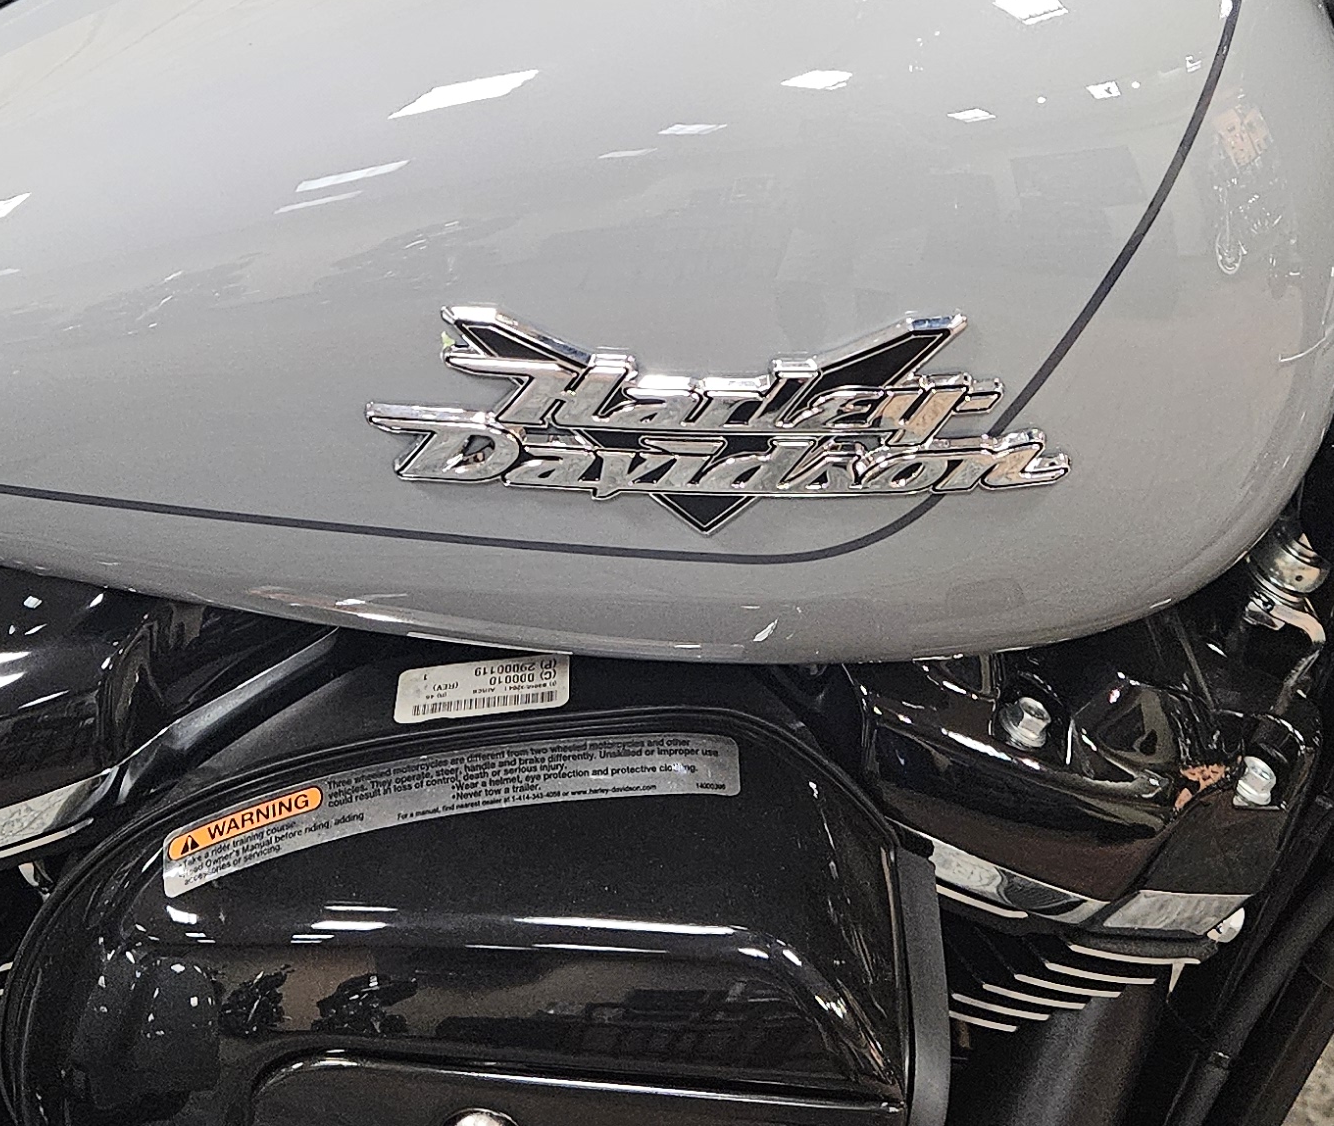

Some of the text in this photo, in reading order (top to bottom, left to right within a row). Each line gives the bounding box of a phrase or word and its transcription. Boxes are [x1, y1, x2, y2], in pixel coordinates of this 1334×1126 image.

[443, 352, 1007, 444] Harley-
[366, 402, 1071, 500] Davidson
[327, 778, 352, 790] Three
[393, 758, 449, 776] motorcycles
[450, 757, 465, 766] are
[467, 750, 505, 763] different
[507, 748, 529, 759] from
[530, 746, 548, 756] two
[588, 739, 645, 752] motorcycles
[646, 739, 665, 748] and
[666, 738, 691, 747] other
[327, 785, 367, 800] vehicles.
[370, 778, 393, 791] They
[435, 766, 463, 778] steer,
[464, 762, 497, 774] handle
[498, 758, 517, 767] and
[518, 754, 546, 765] brake
[547, 751, 597, 765] differently.
[599, 747, 642, 759] Unskilled
[644, 748, 655, 757] or
[657, 746, 699, 758] improper
[701, 748, 719, 757] use
[327, 796, 353, 808] could
[355, 789, 382, 802] result
[382, 786, 392, 795] in
[393, 783, 413, 794] loss
[414, 780, 425, 789] of
[462, 769, 490, 782] death
[491, 770, 503, 779] or
[503, 763, 538, 775] serious
[539, 762, 568, 774] injury.
[489, 775, 524, 787] helmet,
[525, 773, 542, 783] eye
[543, 768, 590, 781] protection
[591, 766, 609, 776] and
[611, 765, 657, 778] protective
[484, 788, 503, 797] tow
[512, 783, 543, 794] trailer.
[207, 793, 309, 841] WARNING
[241, 837, 274, 855] Manual
[274, 827, 304, 844] before
[333, 811, 365, 828] adding
[210, 840, 232, 857] rider
[232, 830, 265, 849] training
[233, 855, 243, 866] or
[243, 843, 283, 863] servicing.
